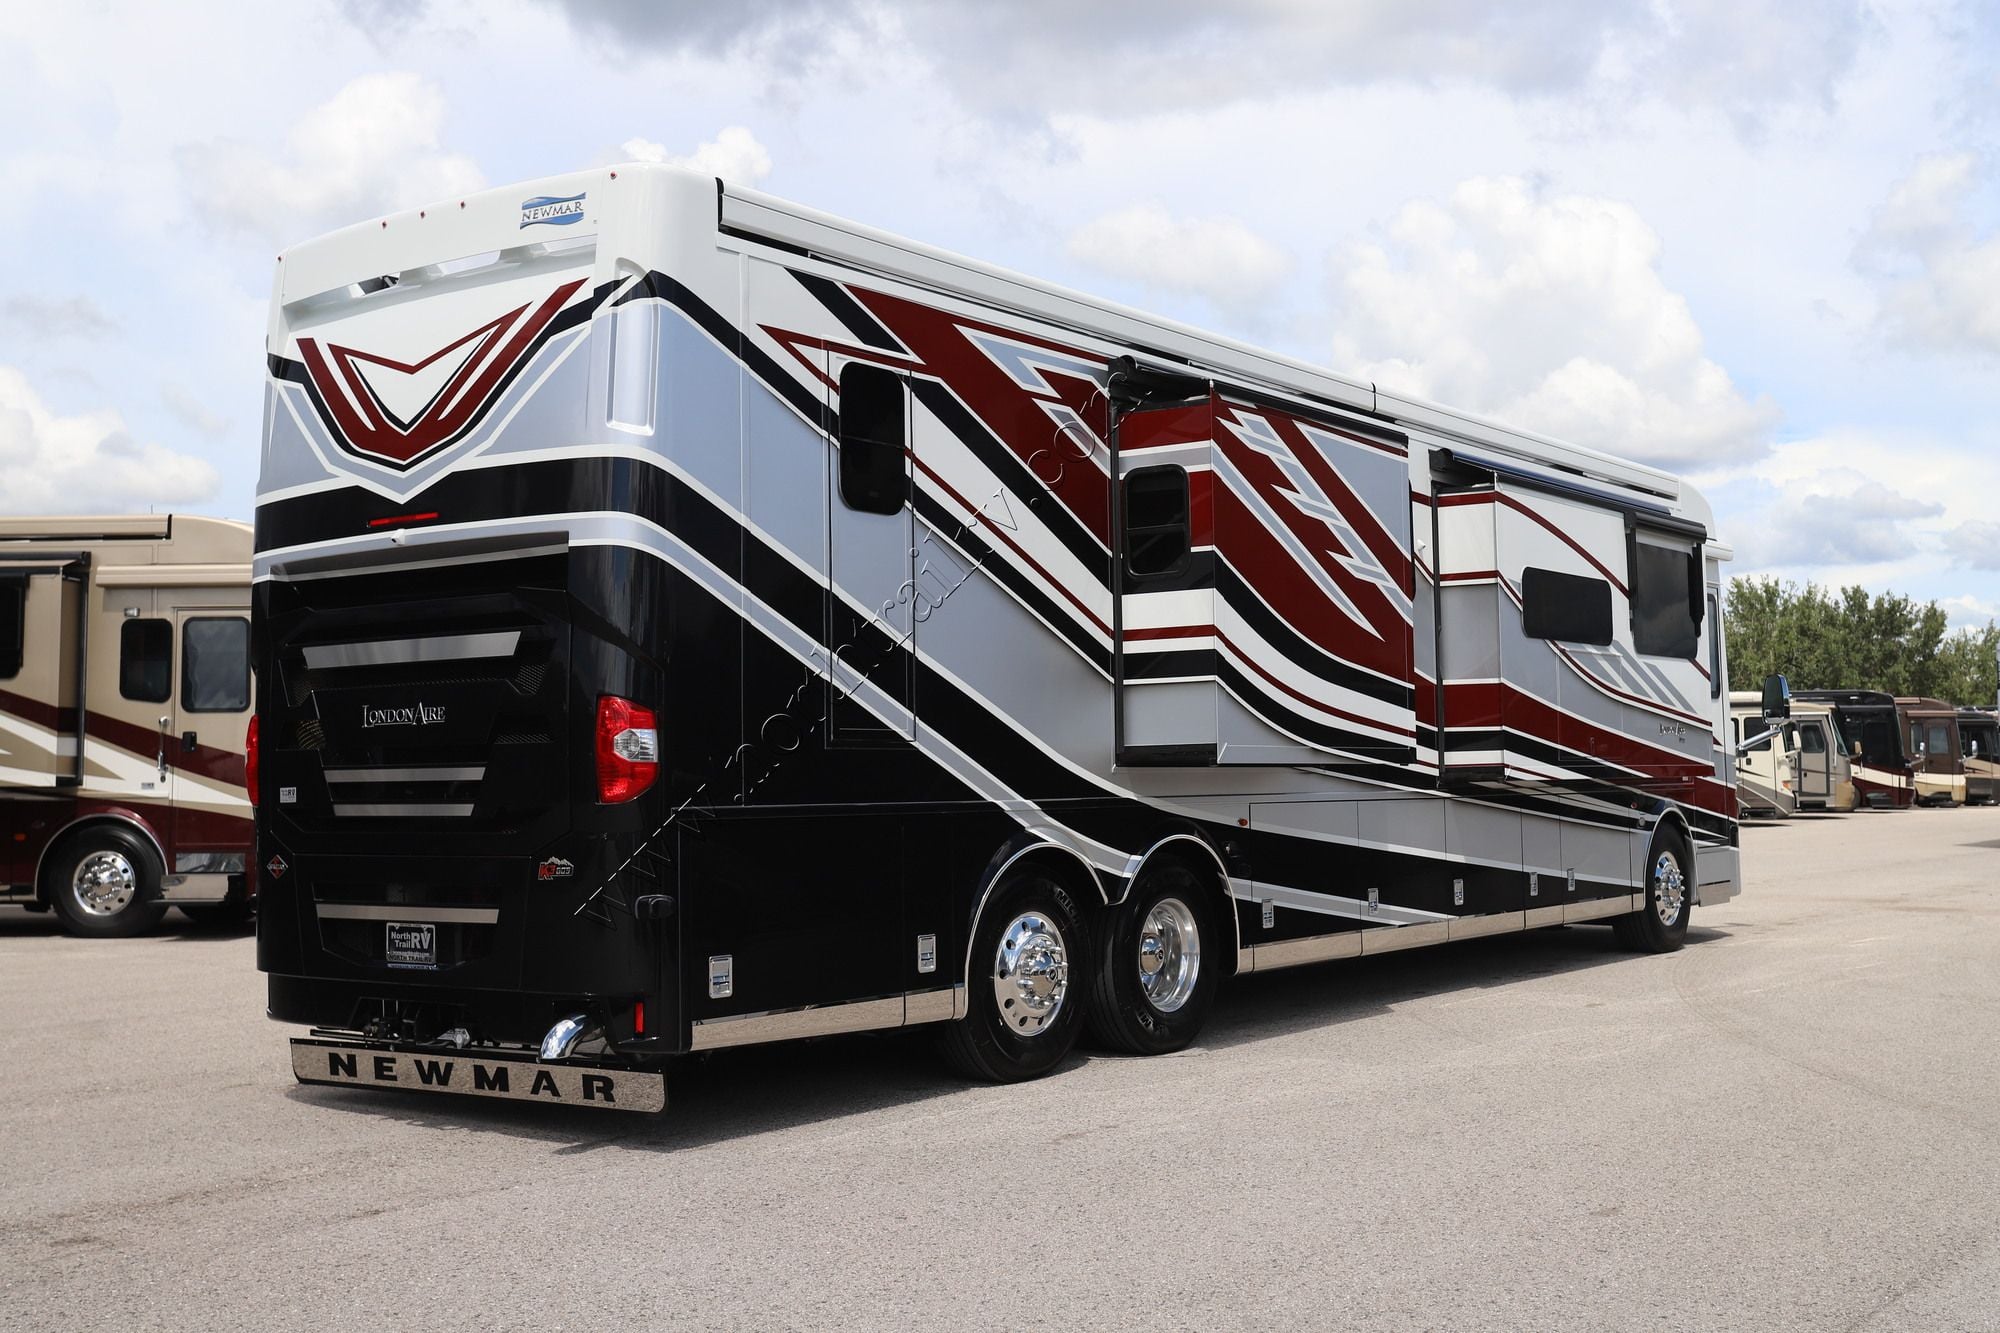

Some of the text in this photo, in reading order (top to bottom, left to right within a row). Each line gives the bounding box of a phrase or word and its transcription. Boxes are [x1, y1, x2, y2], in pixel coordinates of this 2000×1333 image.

[521, 201, 584, 222] NEWMAR
[391, 931, 410, 940] North
[395, 940, 410, 948] Trail
[411, 932, 431, 949] RV
[328, 1052, 617, 1103] NEWMAR
